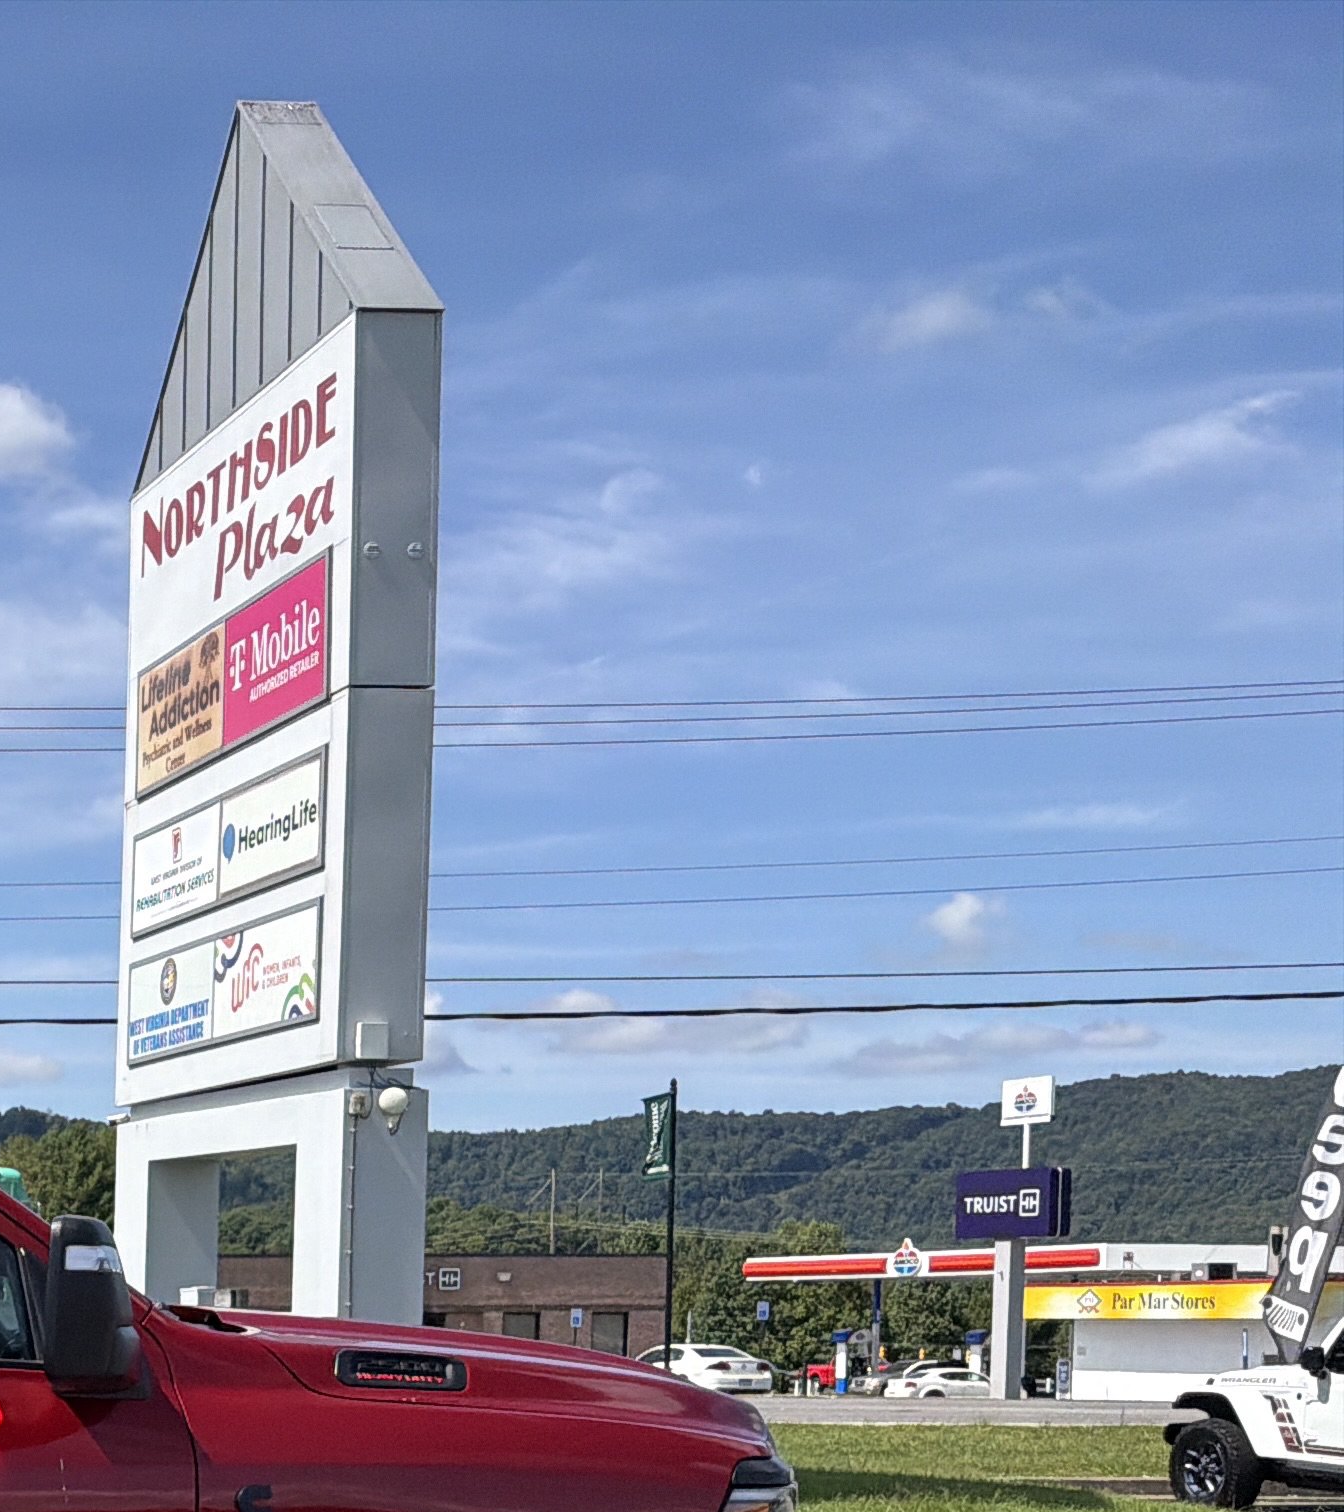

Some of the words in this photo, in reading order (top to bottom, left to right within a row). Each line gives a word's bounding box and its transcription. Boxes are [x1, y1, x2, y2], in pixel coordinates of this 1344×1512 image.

[141, 372, 338, 578] NORTHSIDE
[213, 476, 336, 601] Plaza
[141, 659, 192, 713] Lifeline
[248, 668, 289, 703] AUTHORIZED
[289, 650, 320, 680] RETAILER
[148, 679, 220, 742] Addiction
[237, 797, 317, 854] HearingLife
[186, 867, 215, 893] SERVICES
[168, 1020, 204, 1047] ASSISTANCE
[170, 998, 209, 1026] DEPARTMENT
[963, 1194, 1018, 1214] TRUIST
[1112, 1292, 1135, 1310] Par
[1138, 1292, 1169, 1311] Mar
[1170, 1291, 1216, 1311] Stores
